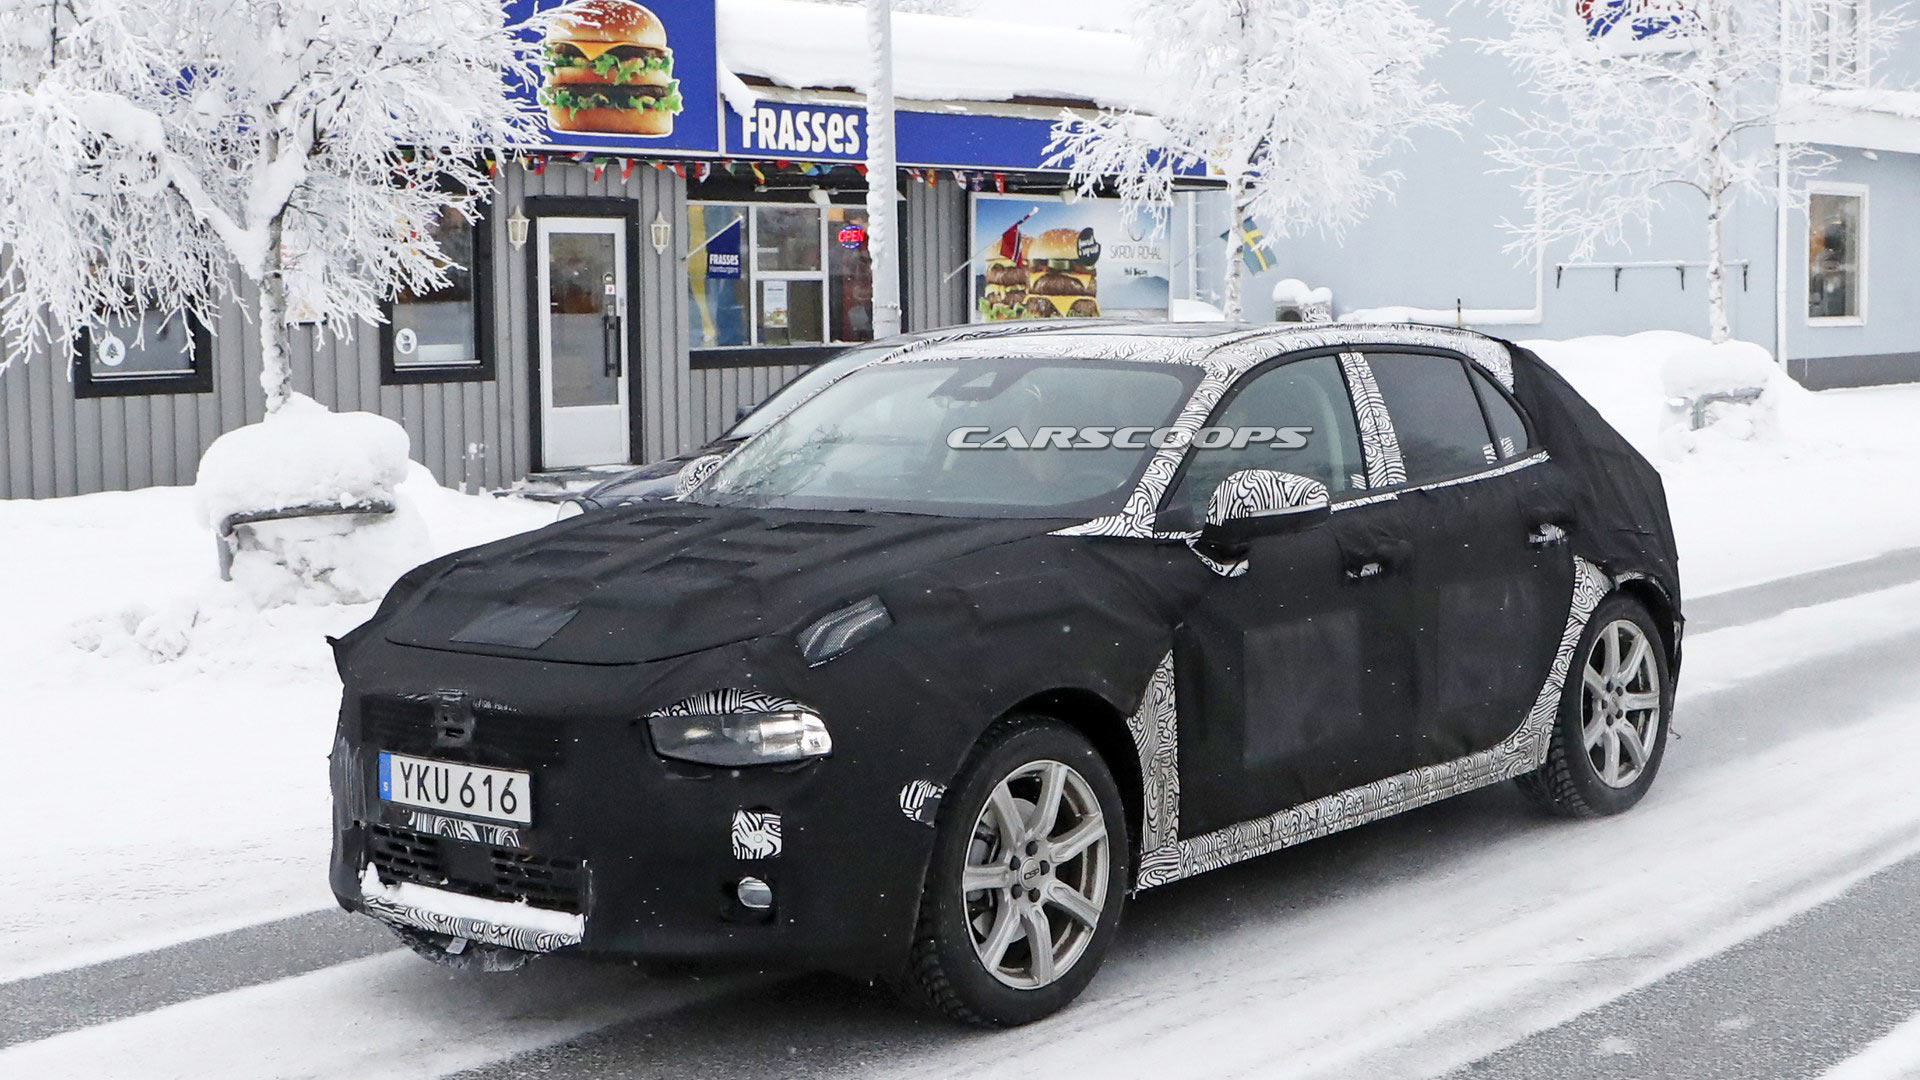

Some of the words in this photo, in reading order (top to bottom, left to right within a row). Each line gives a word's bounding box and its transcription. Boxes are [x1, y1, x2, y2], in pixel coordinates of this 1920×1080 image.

[838, 230, 865, 243] OPEN
[383, 781, 389, 792] S
[400, 761, 449, 804] YKU
[459, 771, 517, 815] 616
